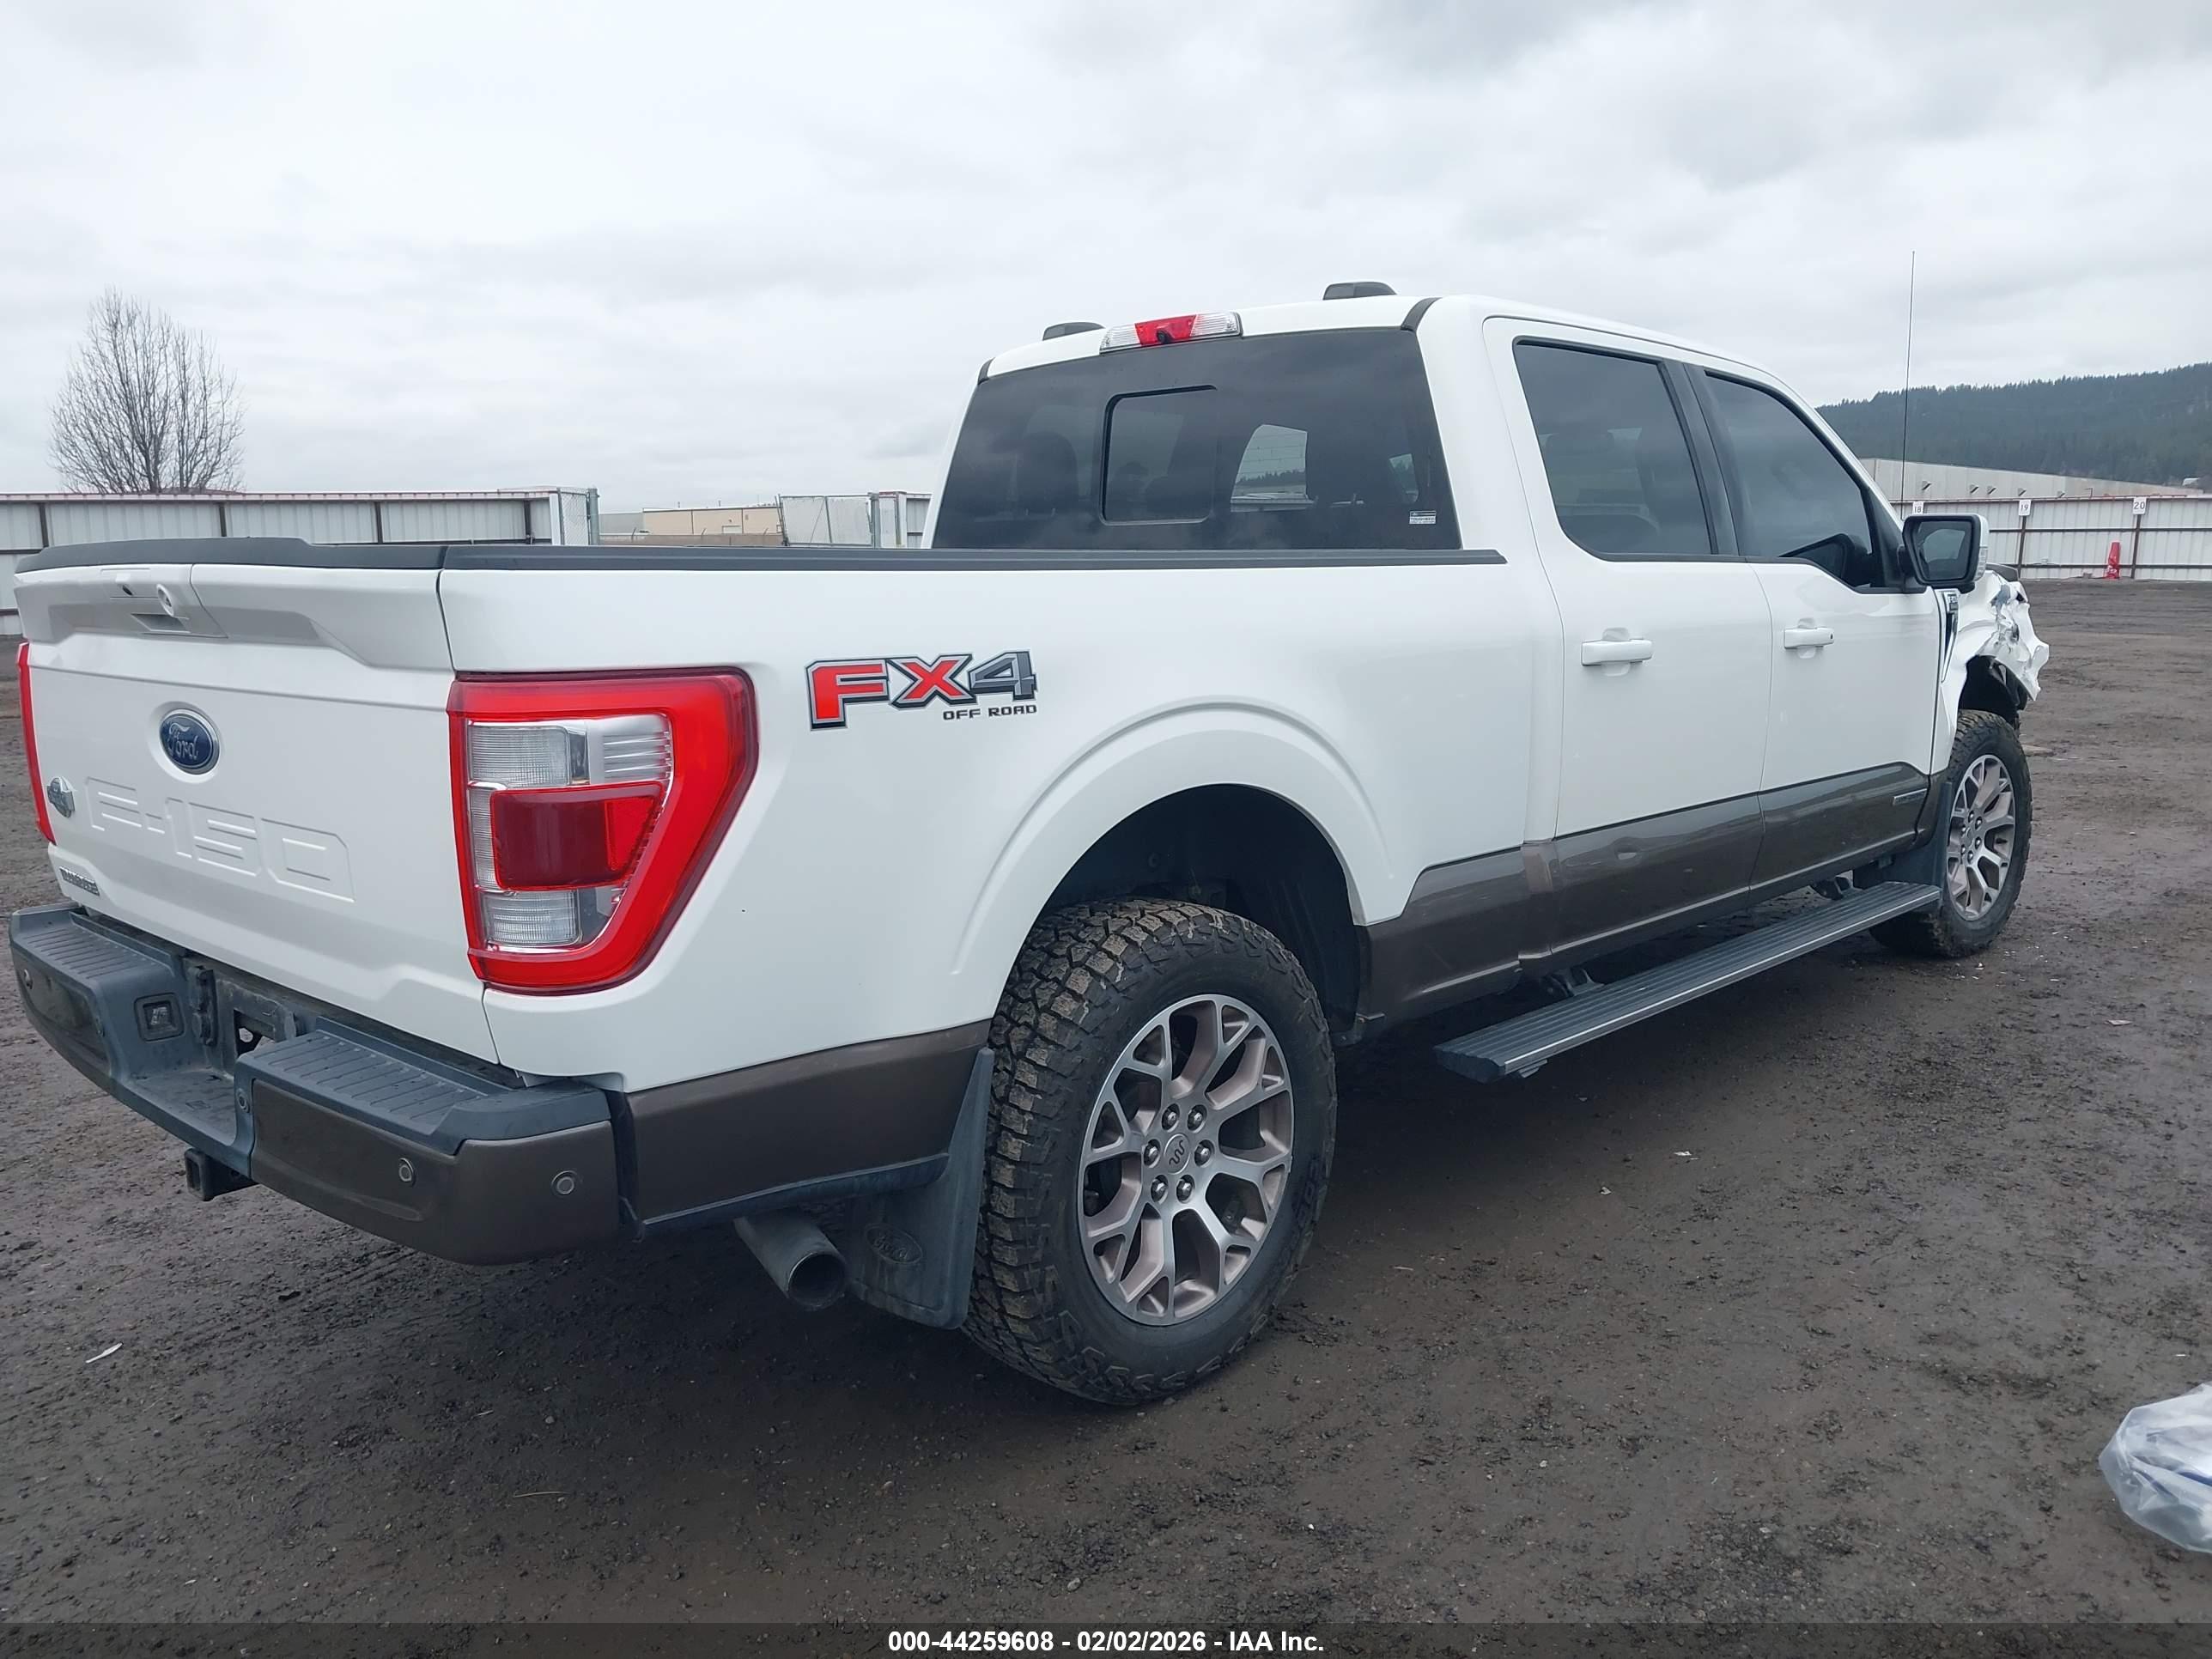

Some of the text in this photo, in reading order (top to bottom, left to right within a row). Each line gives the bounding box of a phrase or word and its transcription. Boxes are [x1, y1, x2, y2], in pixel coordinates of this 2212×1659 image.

[806, 650, 1037, 731] FX4
[943, 704, 1037, 720] OFF ROAD
[167, 722, 199, 760] Ford
[86, 776, 356, 902] F-150
